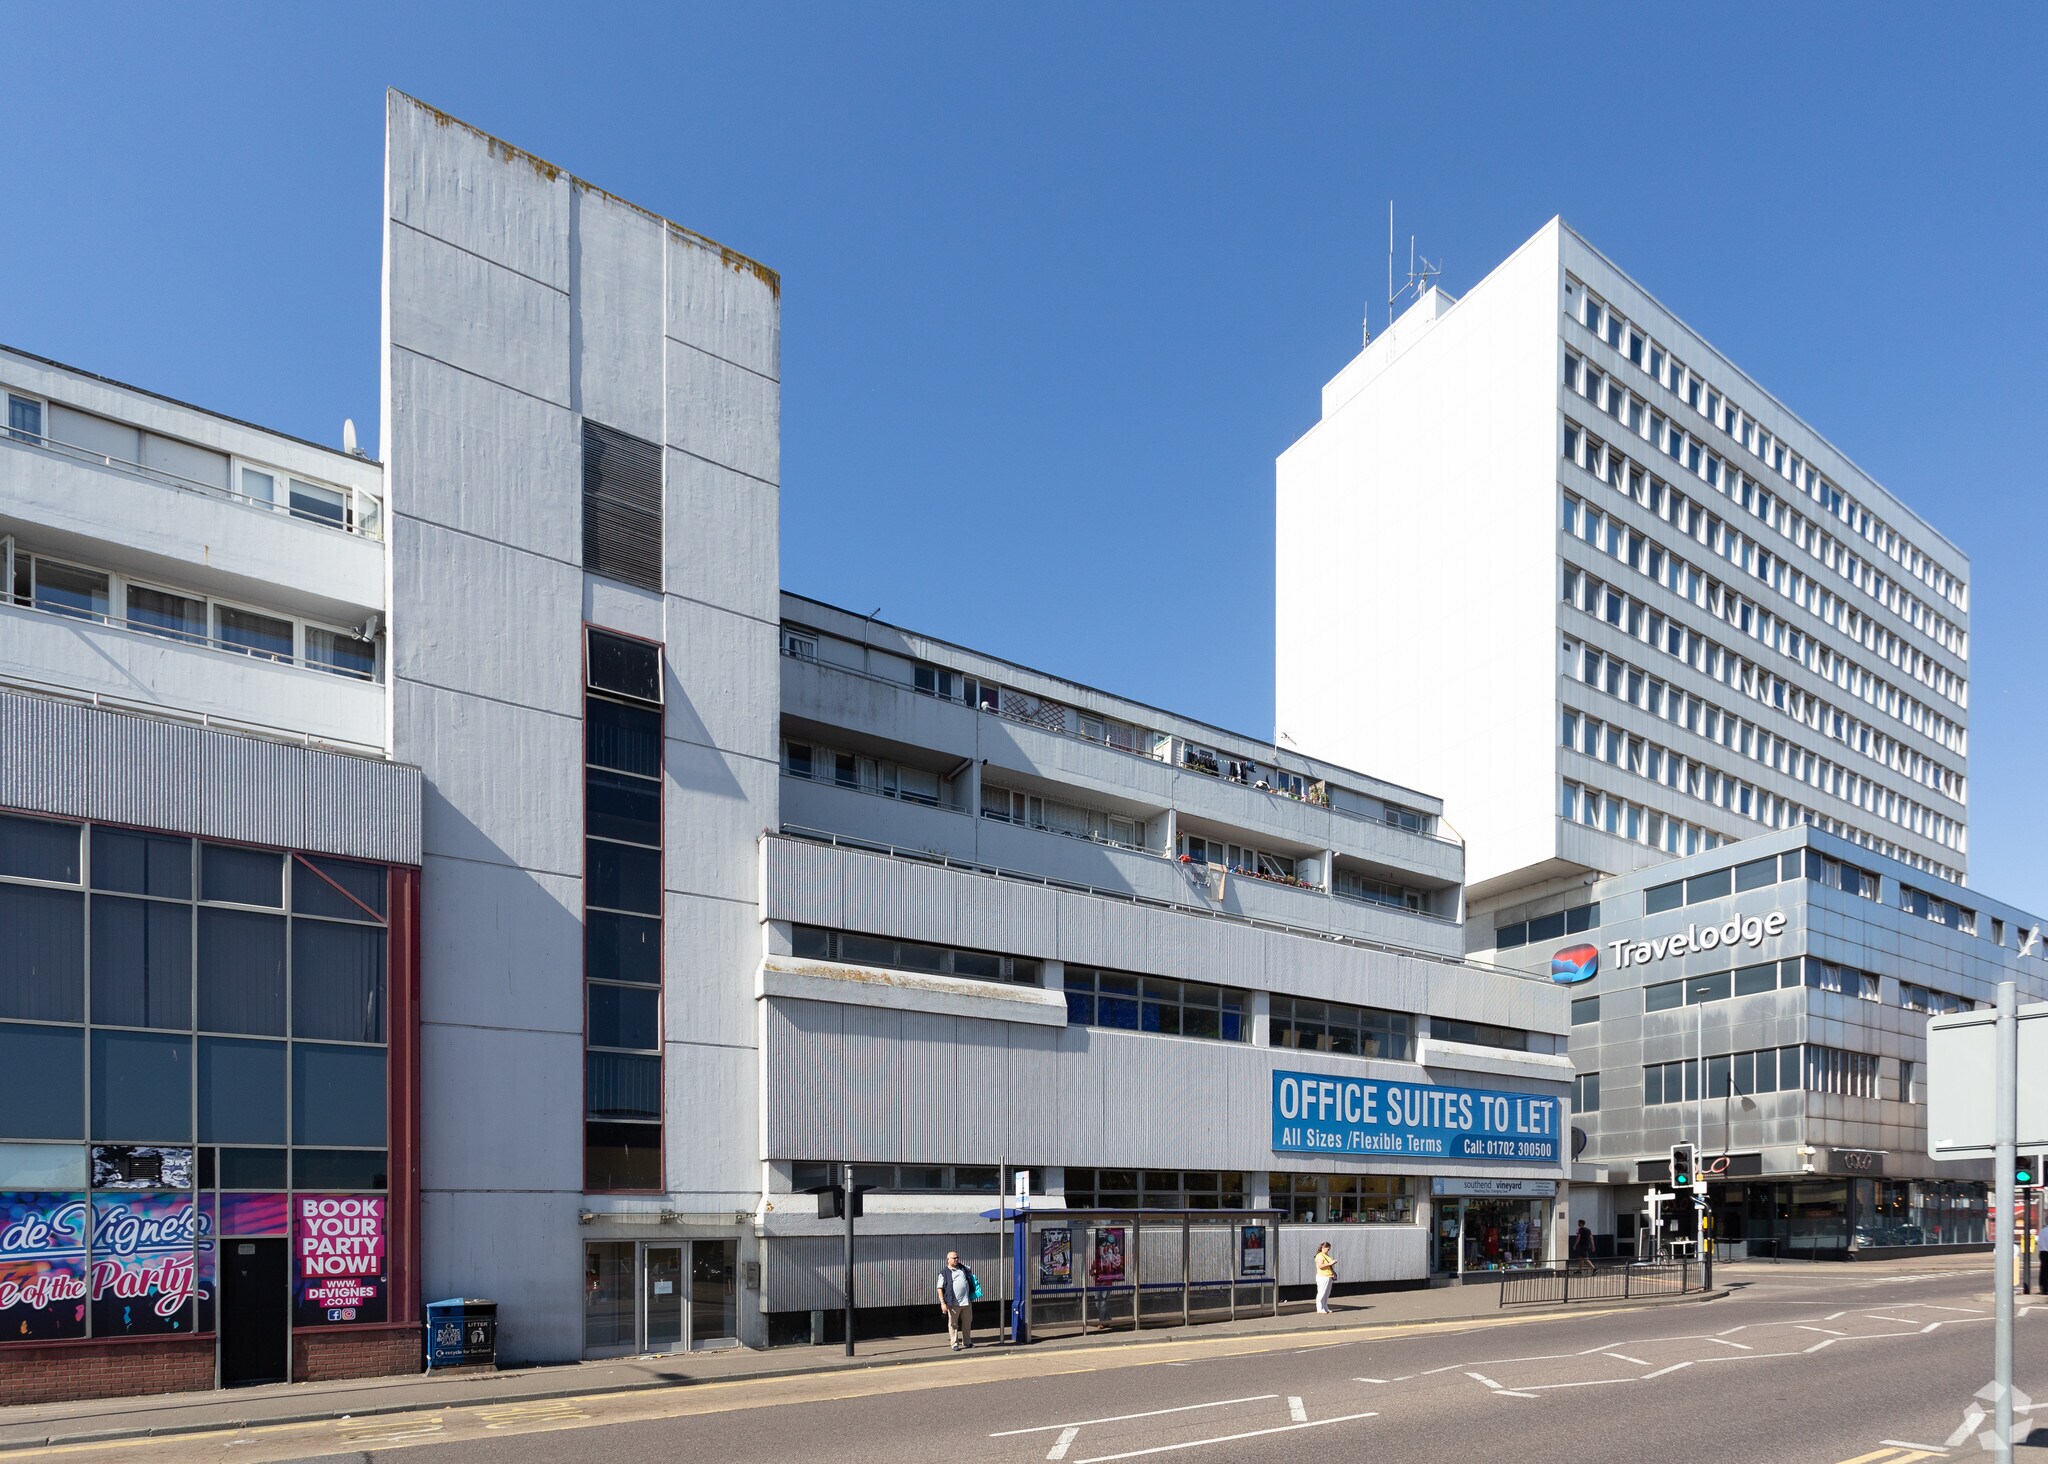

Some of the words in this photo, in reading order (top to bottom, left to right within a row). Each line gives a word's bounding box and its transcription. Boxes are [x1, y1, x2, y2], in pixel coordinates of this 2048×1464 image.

[1608, 911, 1787, 969] Travelodge
[1279, 1077, 1378, 1125] OFFICE
[1386, 1086, 1474, 1131] SUITES
[1479, 1095, 1509, 1133] TO
[1516, 1098, 1553, 1135] LET
[1282, 1127, 1301, 1146] All
[1306, 1128, 1343, 1149] Sizes
[1346, 1131, 1402, 1151] /Flexible
[1406, 1134, 1442, 1153] Terms
[1463, 1138, 1485, 1155] Call:
[1486, 1140, 1515, 1156] 01702
[1517, 1141, 1552, 1157] 300500
[1464, 1180, 1492, 1189] southend
[1496, 1181, 1522, 1191] vineyard
[302, 1199, 379, 1217] BOOK
[2, 1213, 49, 1250] de
[53, 1201, 209, 1254] Vigne's
[305, 1218, 377, 1236] YOUR
[302, 1237, 379, 1255] PARTY
[306, 1255, 377, 1275] NOW!
[23, 1276, 49, 1308] of
[51, 1274, 85, 1301] the
[92, 1256, 209, 1316] Party
[308, 1287, 374, 1299] DEVIGNES
[326, 1280, 357, 1288] WWW.
[324, 1297, 359, 1306] .CO.UK
